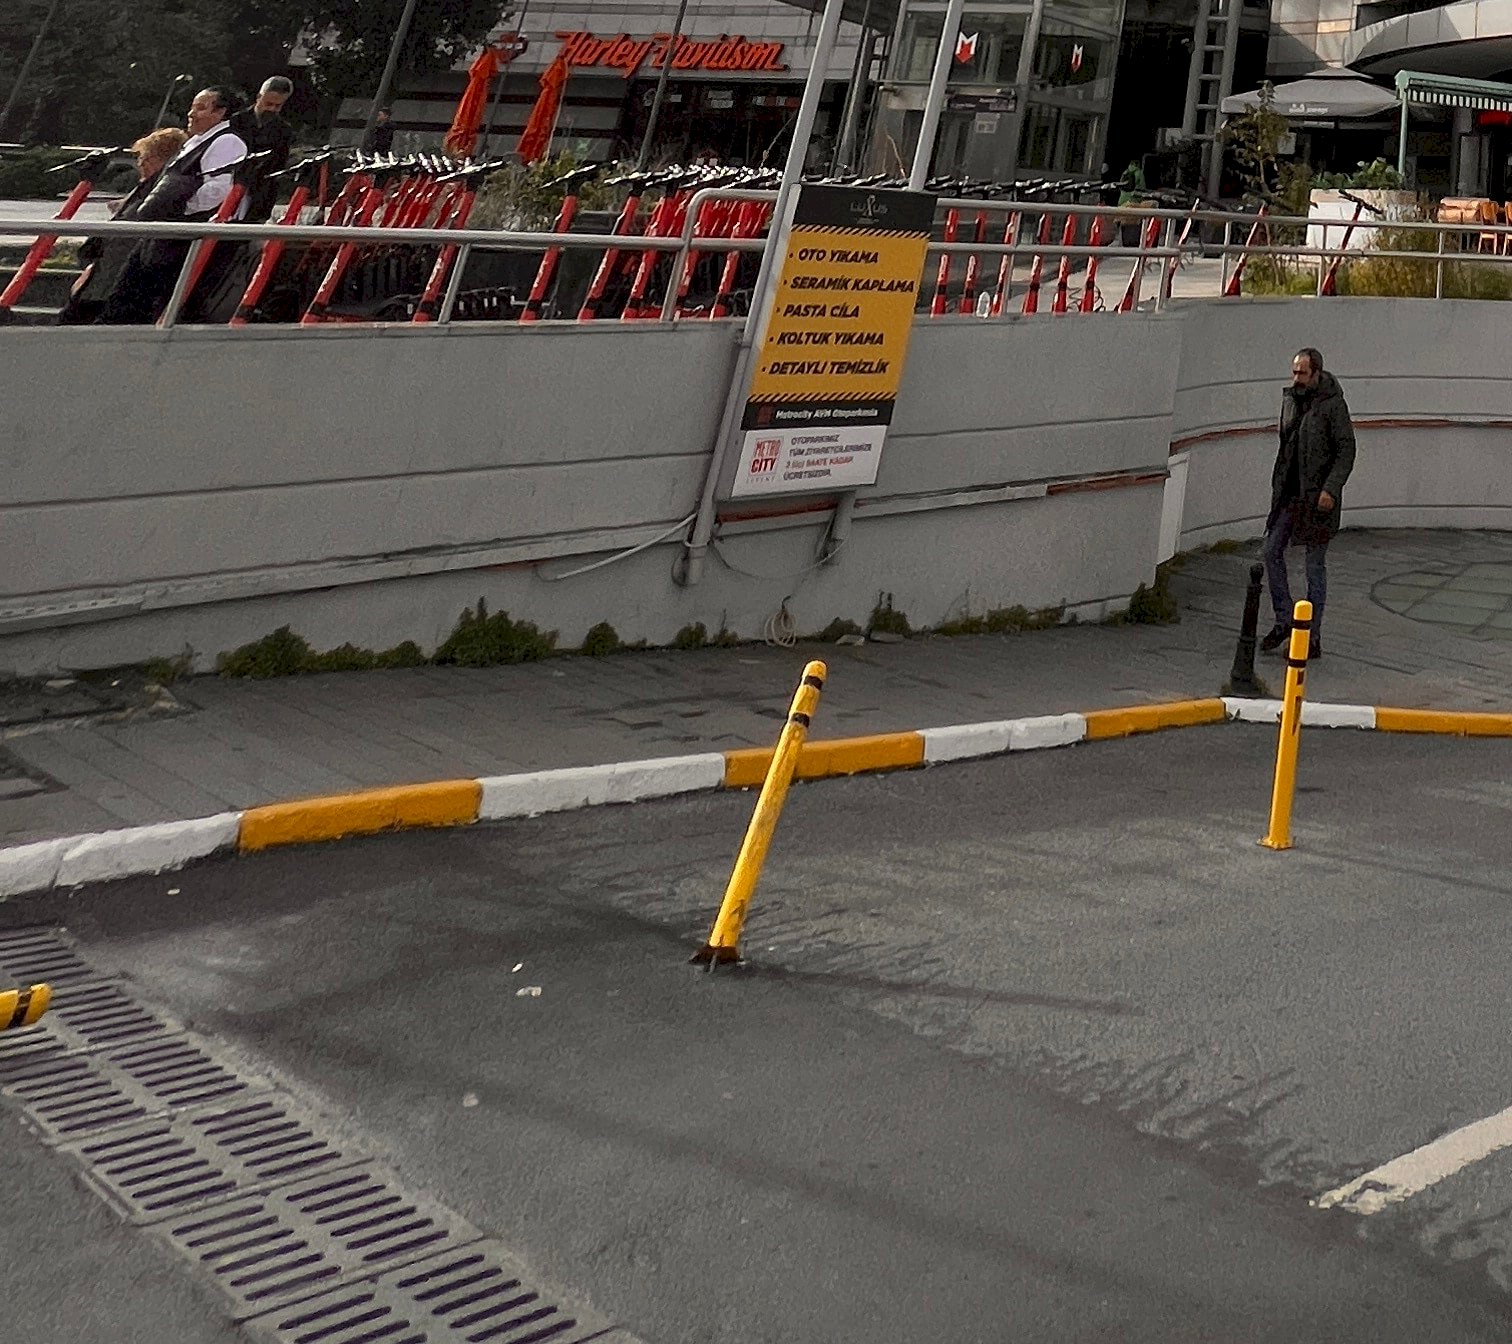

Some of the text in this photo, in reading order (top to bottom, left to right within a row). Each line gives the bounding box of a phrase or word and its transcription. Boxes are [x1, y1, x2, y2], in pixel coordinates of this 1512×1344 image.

[798, 248, 879, 264] OTO YIKAMA
[790, 275, 915, 293] SERAMİK KAPLAMA
[783, 302, 860, 318] PASTA CİLA
[777, 331, 884, 346] KOLTUK YIKAMA
[768, 358, 889, 375] DETAYLI TEMİZLİK
[751, 457, 777, 473] CITY
